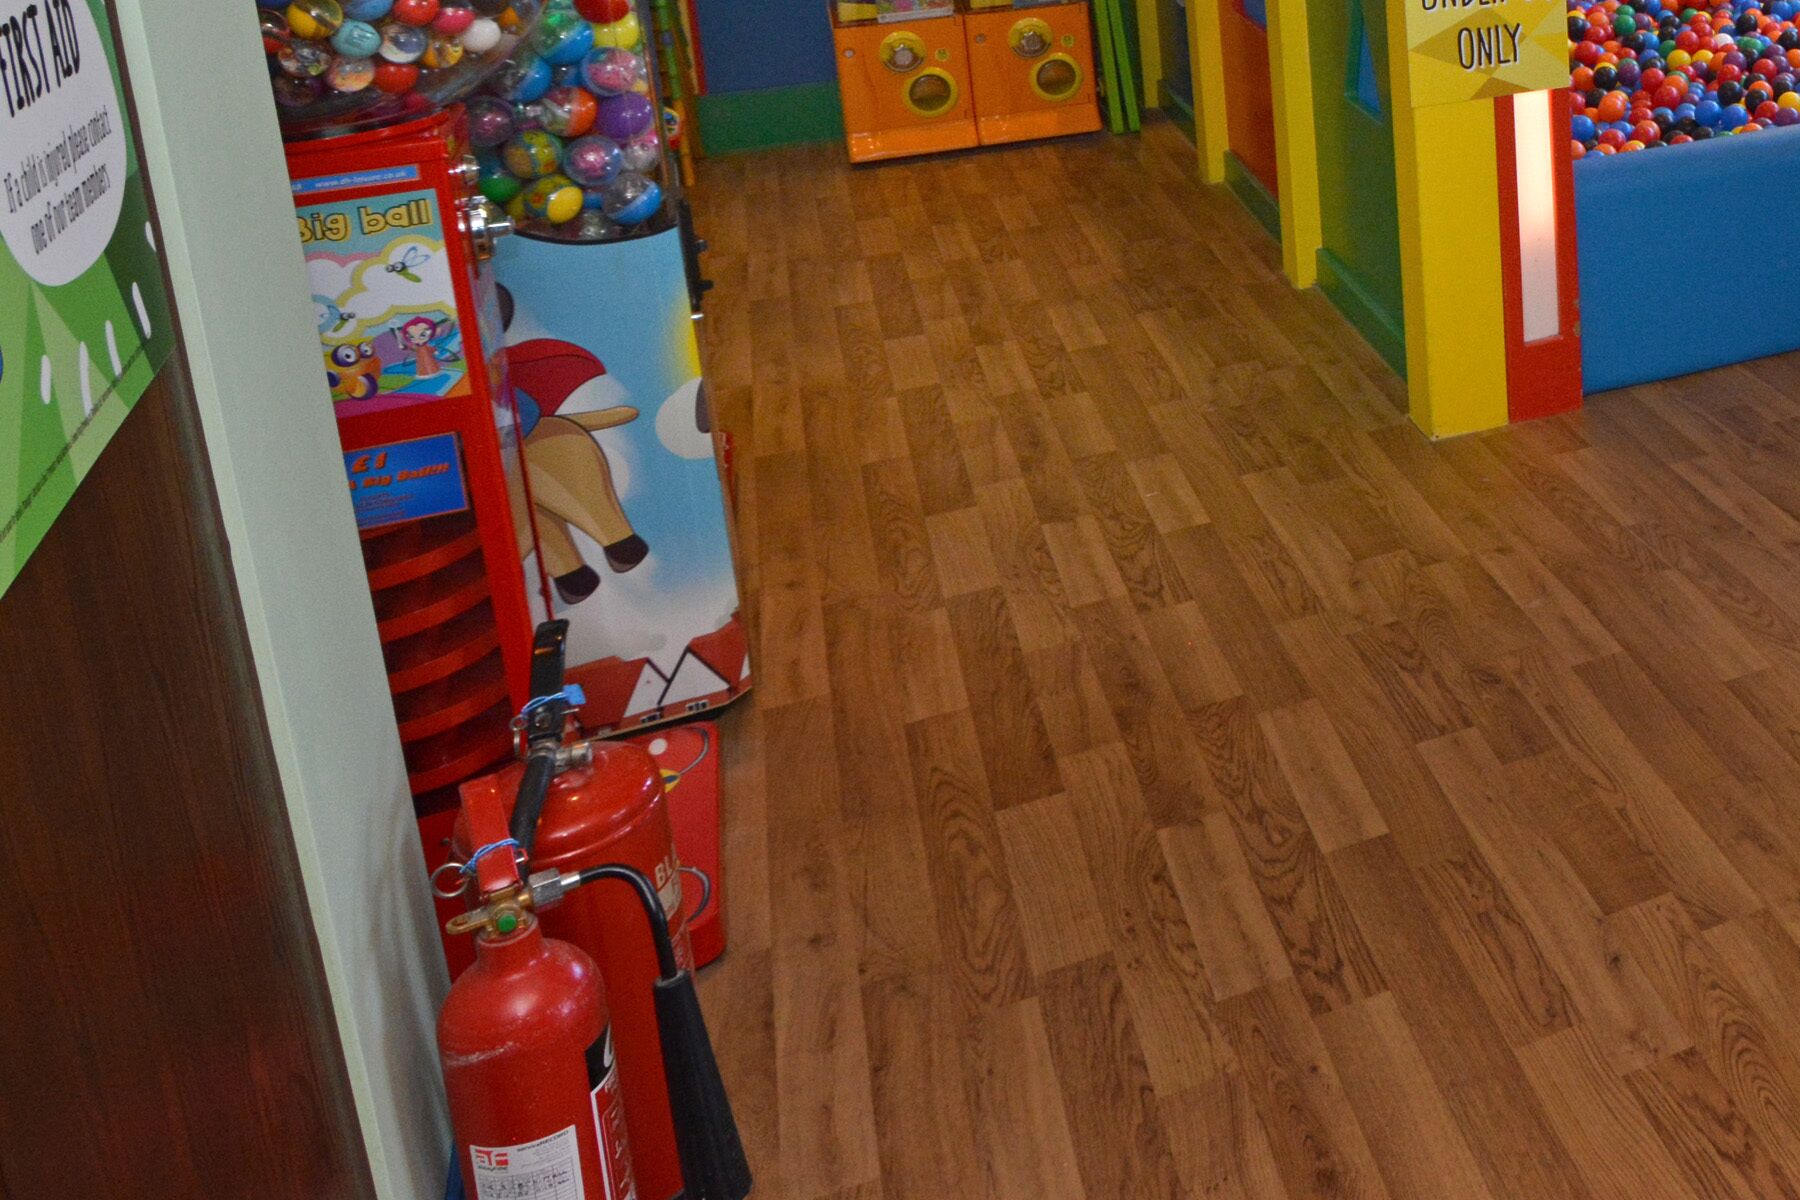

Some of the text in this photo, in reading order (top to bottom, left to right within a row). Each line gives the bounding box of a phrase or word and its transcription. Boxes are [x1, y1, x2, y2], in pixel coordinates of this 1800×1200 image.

[1457, 22, 1522, 70] ONLY
[357, 197, 432, 235] ball
[352, 451, 387, 473] £1
